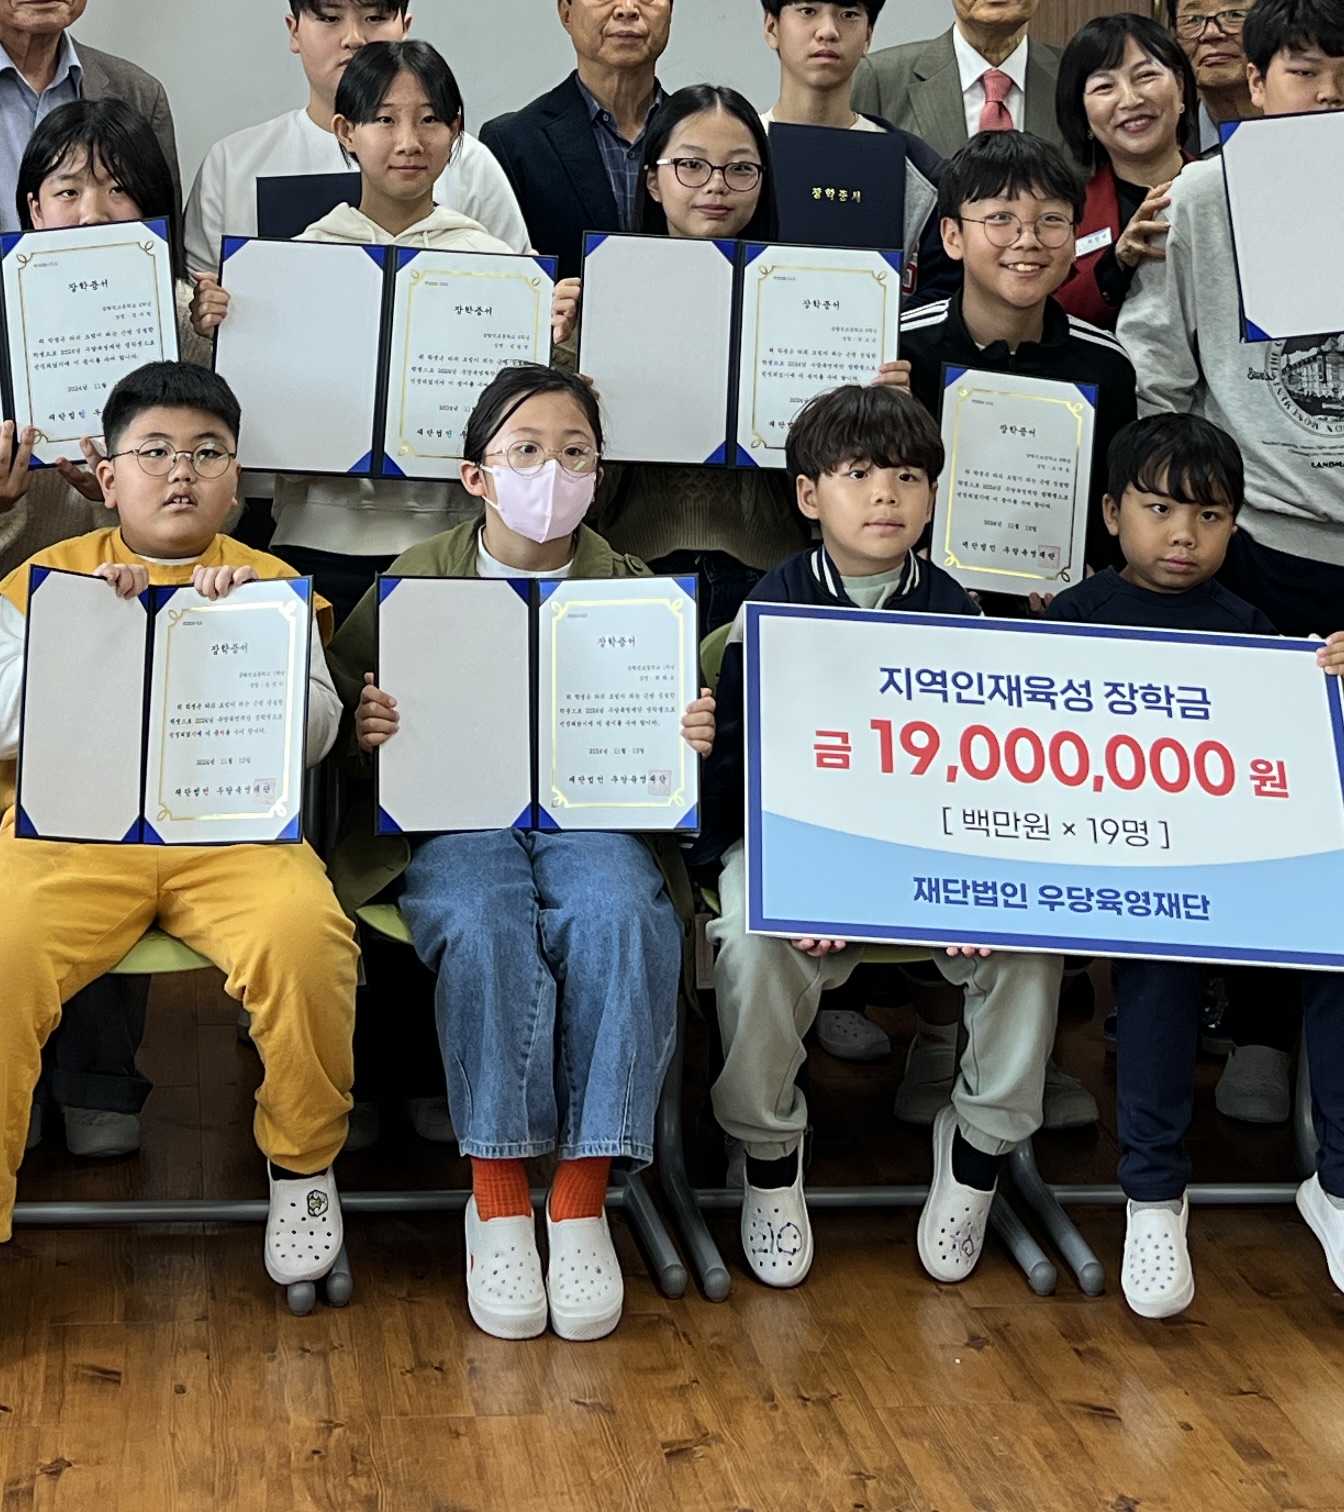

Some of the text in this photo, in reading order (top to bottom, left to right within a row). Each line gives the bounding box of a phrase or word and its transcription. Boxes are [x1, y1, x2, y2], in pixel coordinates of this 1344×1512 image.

[811, 186, 862, 204] 장학증서
[880, 668, 1211, 720] 지역인재육성 장학금
[814, 718, 1288, 798] 금 19,000,000 원
[963, 809, 1050, 840] 백만원
[1087, 818, 1149, 846] 19명
[914, 877, 1210, 921] 재단법인 우당육영재단
